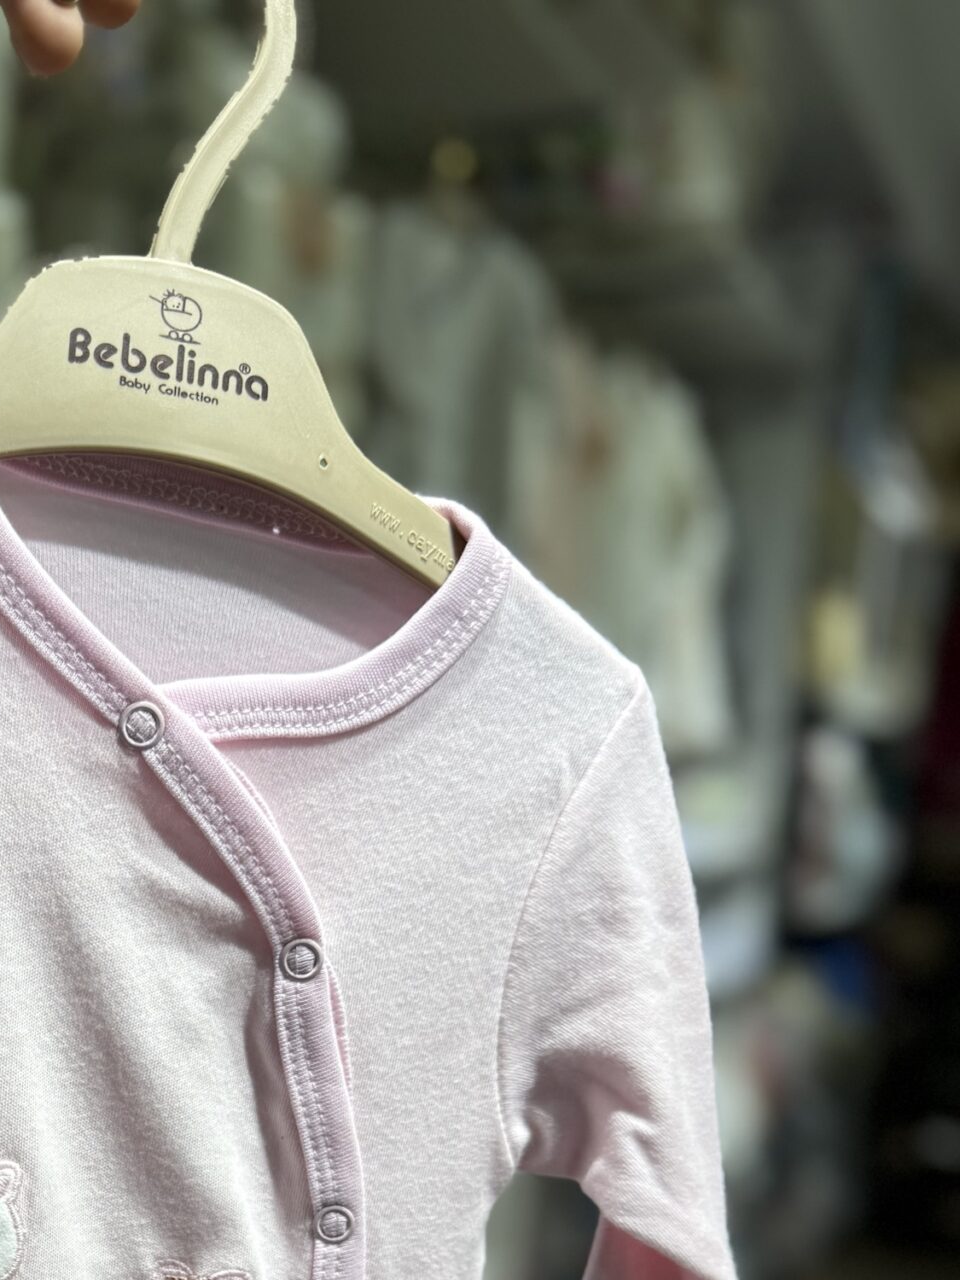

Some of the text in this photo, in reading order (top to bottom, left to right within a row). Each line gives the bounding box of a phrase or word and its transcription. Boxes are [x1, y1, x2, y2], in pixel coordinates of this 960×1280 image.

[67, 327, 269, 401] Bebelinna
[119, 375, 219, 406] Baby Collection
